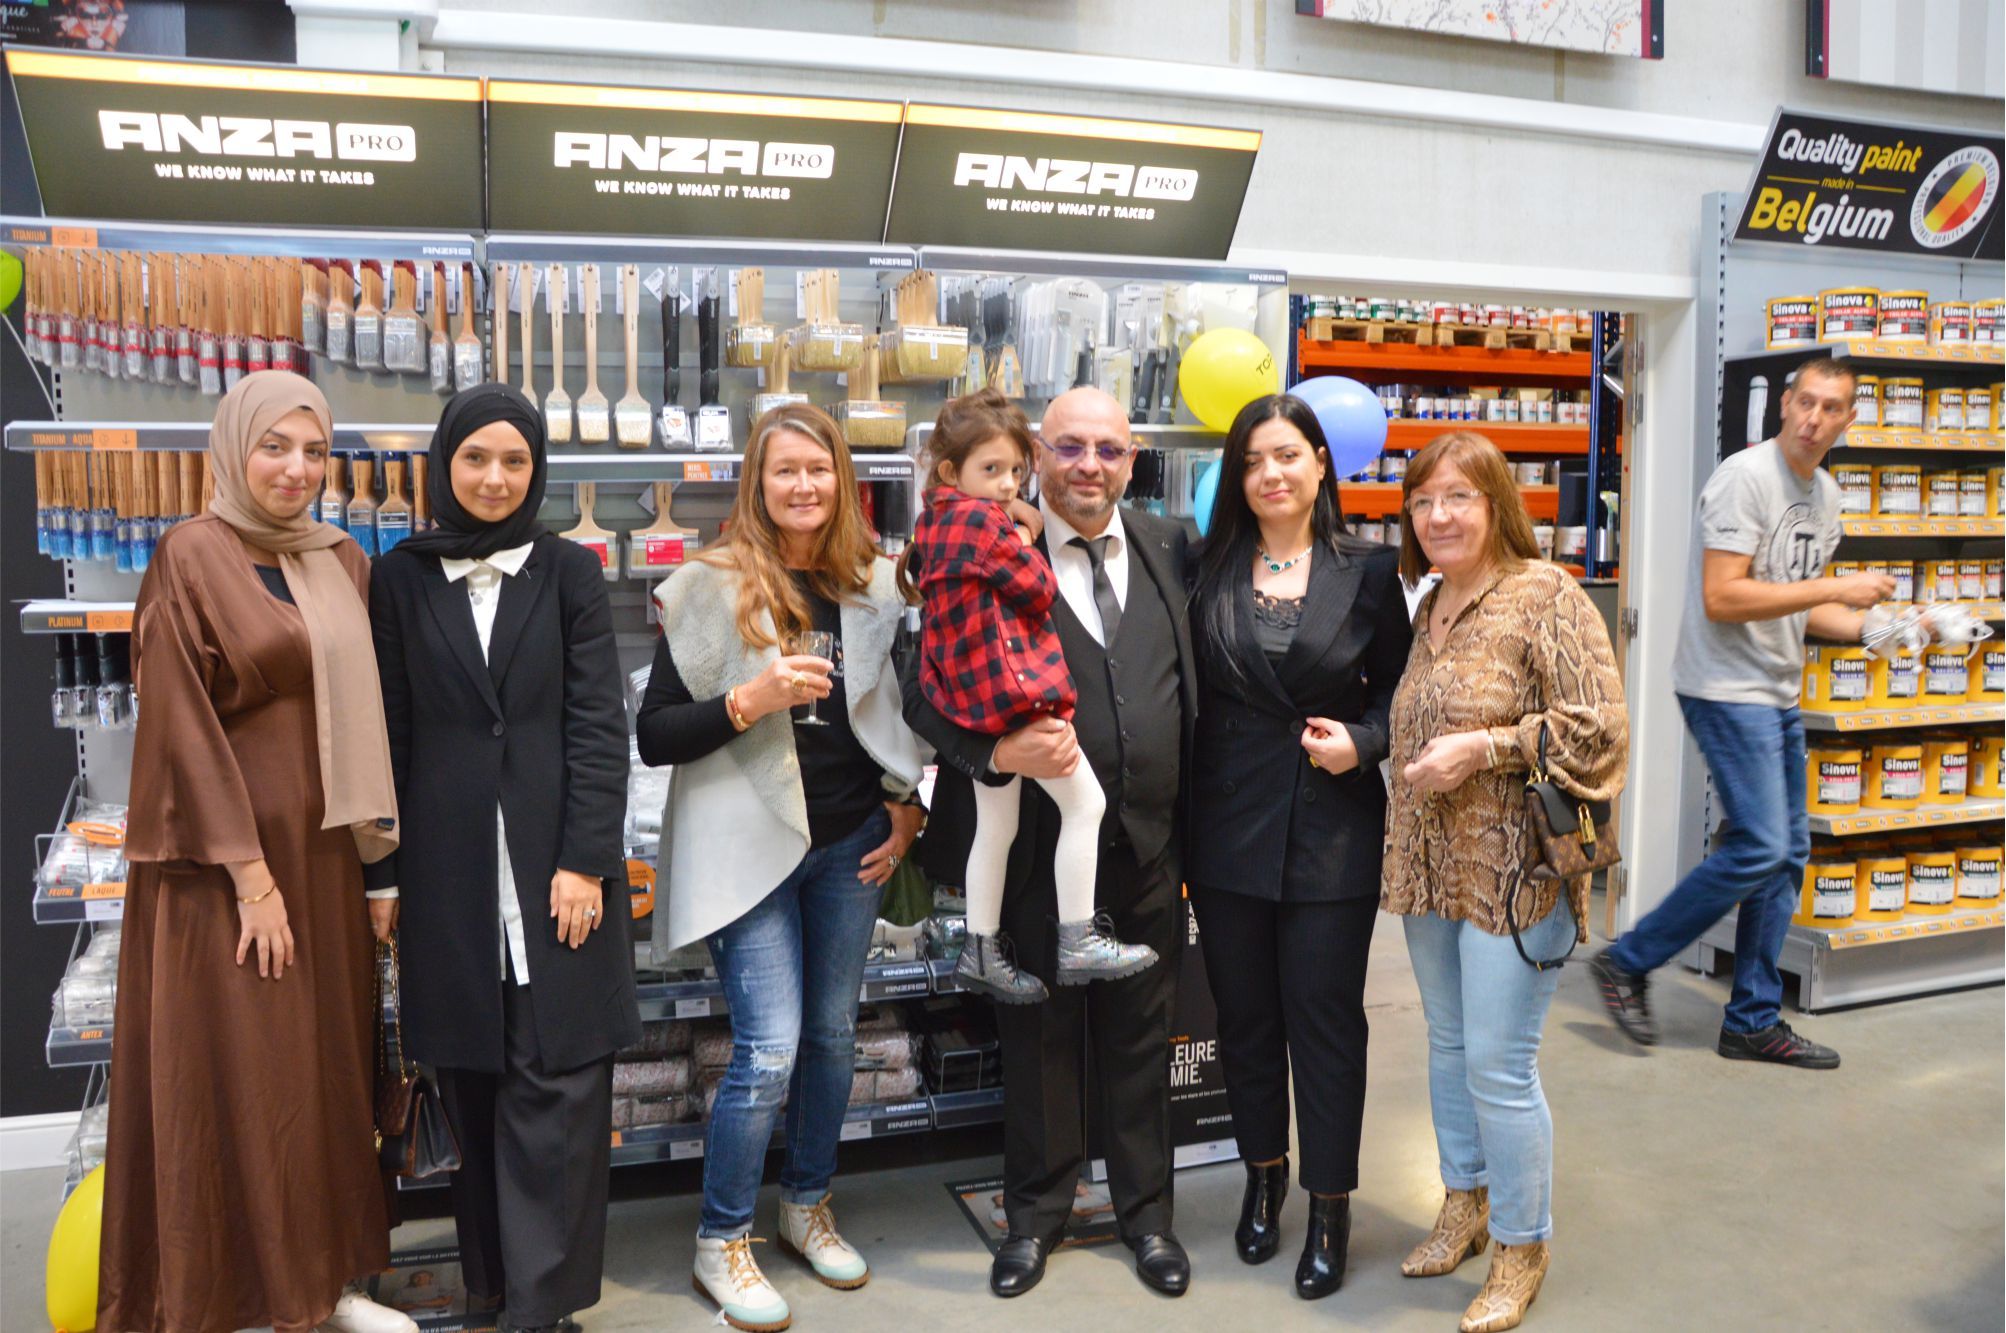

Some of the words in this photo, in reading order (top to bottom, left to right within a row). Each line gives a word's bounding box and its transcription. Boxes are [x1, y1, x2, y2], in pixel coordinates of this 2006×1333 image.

[98, 110, 333, 159] ANZA
[349, 134, 404, 152] PRO
[554, 131, 760, 175] ANZA
[774, 152, 824, 169] PRO
[1777, 128, 1863, 174] Quality
[1859, 140, 1923, 174] paint
[155, 164, 183, 178] WE
[188, 165, 242, 181] KNOW
[247, 167, 296, 182] WHAT
[301, 170, 315, 184] IT
[320, 170, 375, 186] TAKES
[954, 152, 1135, 197] ANZA
[1145, 176, 1188, 192] PRO
[594, 179, 620, 194] WE
[624, 181, 673, 196] KNOW
[677, 183, 721, 198] WHAT
[724, 185, 739, 199] IT
[742, 185, 791, 201] TAKES
[1821, 177, 1844, 189] made
[1845, 177, 1855, 190] in
[986, 198, 1008, 211] WE
[1010, 200, 1054, 214] KNOW
[1057, 202, 1095, 217] WHAT
[1098, 205, 1112, 219] IT
[1114, 206, 1156, 221] TAKES
[1748, 187, 1895, 245] Belgium
[12, 228, 47, 242] TITANIUM
[869, 257, 901, 267] ANZA
[1248, 273, 1276, 283] ANZA
[1826, 294, 1863, 307] Sinova
[1881, 297, 1918, 311] Sinova
[1773, 303, 1808, 316] Sinova
[32, 433, 66, 445] TITANIUM
[48, 616, 83, 628] PLATINUM
[1928, 655, 1963, 667] Sinova
[1822, 763, 1857, 776] Sinova
[1912, 865, 1947, 878] Sinova
[1961, 859, 1996, 872] Sinova
[1817, 877, 1851, 890] Sinova
[80, 1030, 104, 1040] ANTEX
